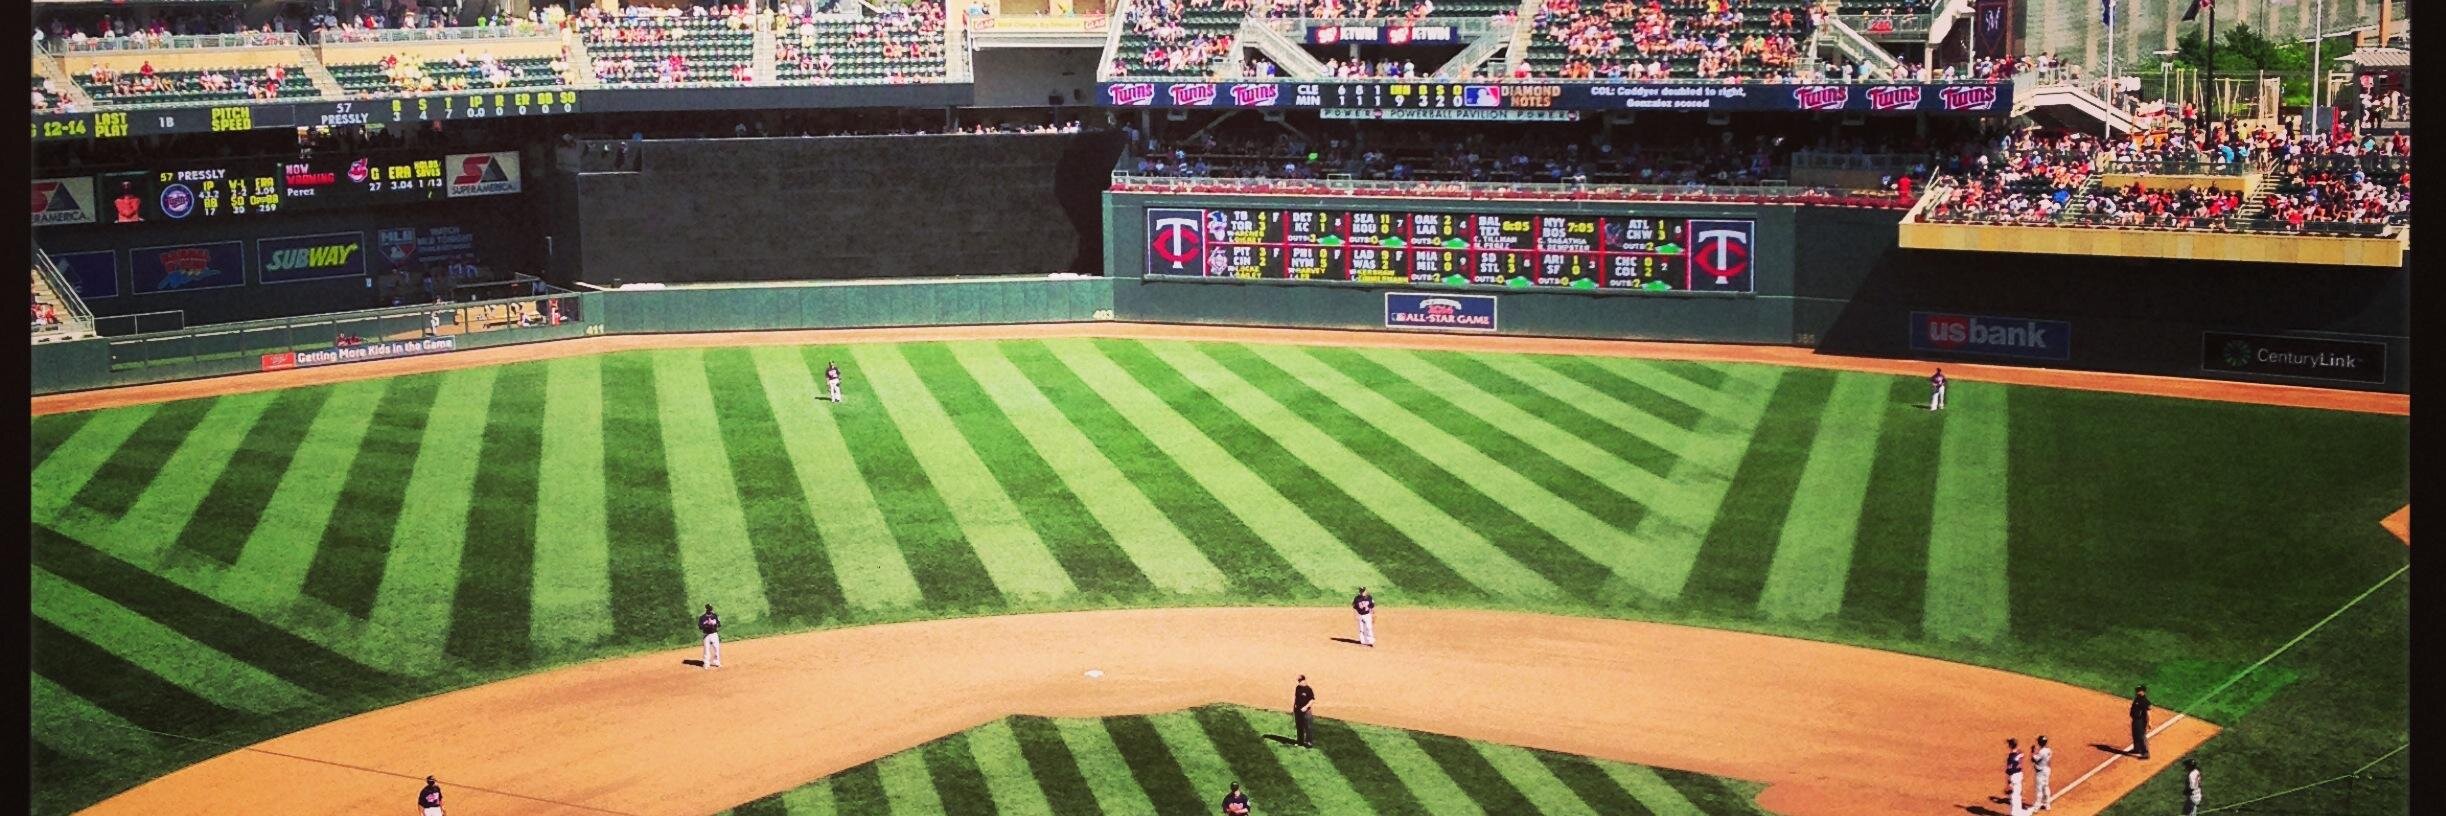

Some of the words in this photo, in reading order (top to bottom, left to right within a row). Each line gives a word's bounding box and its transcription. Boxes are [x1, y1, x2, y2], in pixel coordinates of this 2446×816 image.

[1108, 83, 1155, 105] Twins
[1168, 83, 1217, 105] Twins
[1230, 83, 1278, 106] Twins
[1297, 84, 1319, 95] CLE
[1374, 85, 1381, 95] 1
[1436, 85, 1445, 95] S
[1501, 85, 1561, 96] DIAMOND
[1661, 87, 1703, 96] doubled
[1705, 87, 1716, 96] to
[419, 98, 427, 110] S
[444, 97, 452, 108] T
[470, 96, 482, 107] IP
[515, 94, 530, 106] ER
[560, 91, 576, 103] SO
[1296, 95, 1321, 106] MIN
[1339, 96, 1345, 106] 1
[1357, 96, 1363, 106] 1
[1374, 96, 1381, 106] 1
[1395, 95, 1405, 106] 9
[1418, 96, 1428, 106] 3
[1435, 96, 1445, 107] 2
[1453, 96, 1463, 107] 0
[1511, 96, 1551, 107] NOTES
[1794, 86, 1848, 109] Twins
[1866, 86, 1921, 109] Twins
[1939, 86, 1996, 110] Twins
[336, 103, 351, 113] 57
[1674, 99, 1710, 108] scored
[211, 107, 250, 119] PITCH
[393, 112, 400, 121] 3
[419, 111, 427, 120] 4
[467, 107, 485, 118] 0.0
[496, 106, 503, 116] 0
[519, 105, 527, 115] 0
[542, 103, 549, 114] 0
[564, 102, 572, 113] 0
[1391, 110, 1451, 118] POWERBALL
[1456, 110, 1507, 119] PAVILION
[95, 112, 127, 125] LAST
[159, 117, 174, 127] 1B
[321, 113, 369, 125] PRESSLY
[43, 120, 86, 136] 12-14
[211, 118, 251, 131] SPEED
[95, 125, 128, 137] PLAY
[178, 169, 226, 180] PRESSLY
[286, 164, 308, 175] NOW
[371, 168, 380, 180] G
[388, 165, 412, 179] ERA
[203, 180, 214, 191] IP
[369, 181, 381, 191] 27
[391, 181, 413, 190] 3.04
[288, 187, 315, 197] Perez
[1258, 211, 1266, 220] 4
[1319, 212, 1327, 222] 3
[1353, 213, 1374, 223] SEA
[1414, 214, 1438, 225] OAK
[1443, 215, 1451, 225] 2
[1479, 216, 1501, 226] BAL
[1231, 220, 1253, 230] TOR
[1320, 222, 1325, 232] 1
[1416, 224, 1437, 234] LAA
[1567, 222, 1594, 233] 7:05
[1628, 219, 1649, 229] ATL
[1542, 227, 1566, 238] BOS
[1627, 229, 1653, 239] CHW
[266, 243, 358, 271] SUBWAY
[1354, 249, 1375, 260] LAD
[1233, 256, 1251, 265] CIN
[1259, 257, 1266, 266] 2
[1353, 259, 1376, 269] WAS
[1416, 261, 1437, 271] MIL
[1480, 263, 1500, 273] STL
[1614, 266, 1637, 276] COL
[1644, 267, 1652, 277] 2
[1405, 313, 1456, 324] ALL-STAR
[1457, 315, 1490, 325] GAME
[298, 351, 337, 363] Getting
[339, 348, 366, 359] More
[369, 344, 391, 355] Kids
[405, 341, 421, 352] the
[423, 338, 453, 350] Game
[2258, 348, 2356, 368] CenturyLink
